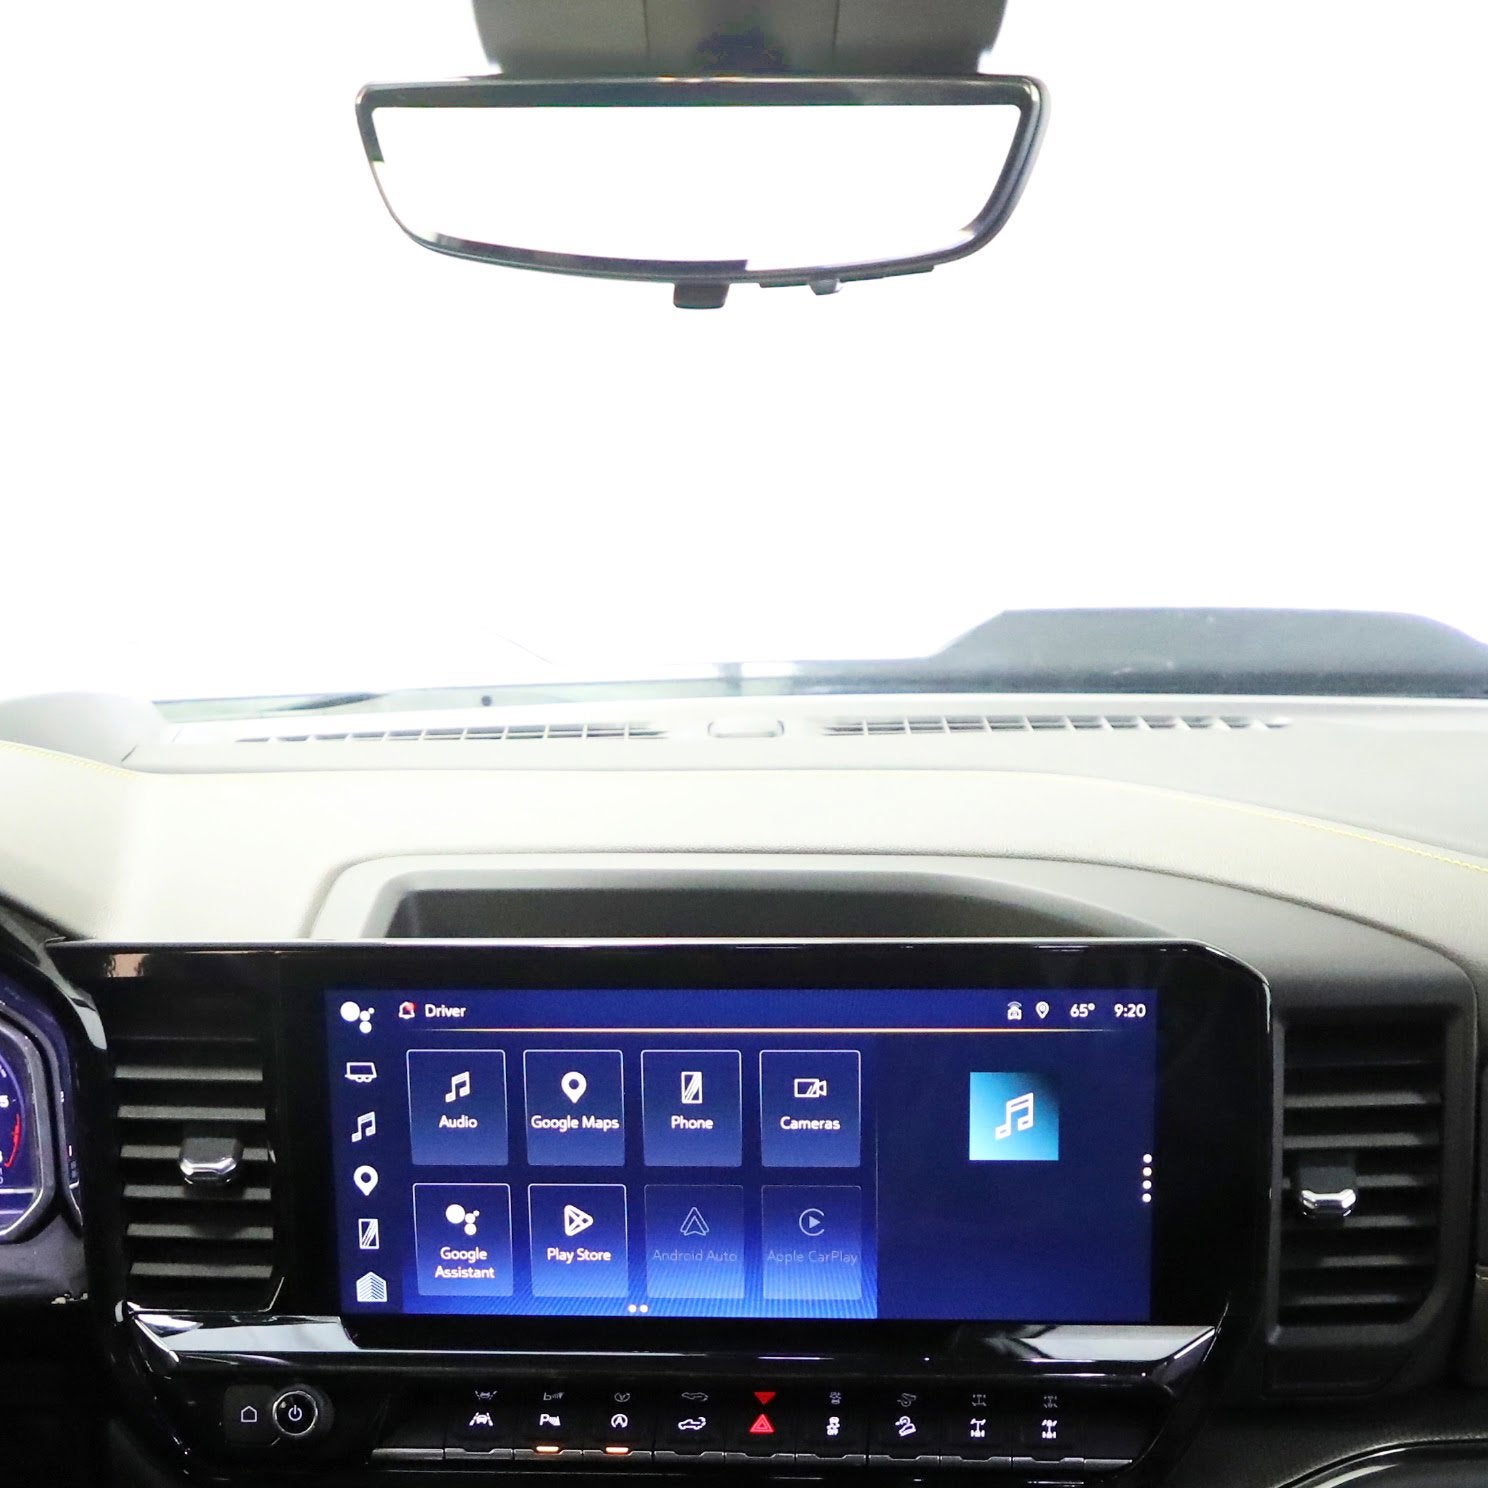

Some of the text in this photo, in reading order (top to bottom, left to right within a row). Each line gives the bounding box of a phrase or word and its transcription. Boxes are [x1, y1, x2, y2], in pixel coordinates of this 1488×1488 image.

[424, 1004, 467, 1018] Driver
[1070, 1003, 1095, 1018] 65°
[1114, 1003, 1147, 1018] 9:20
[438, 1115, 478, 1129] Audio
[531, 1116, 620, 1132] Google Maps
[671, 1115, 714, 1130] Phone
[780, 1116, 841, 1130] Cameras
[440, 1247, 488, 1263] Google
[547, 1247, 612, 1264] Play Store
[653, 1250, 738, 1262] Android Auto
[767, 1250, 858, 1266] Apple CarPlay
[434, 1265, 495, 1279] Assistant
